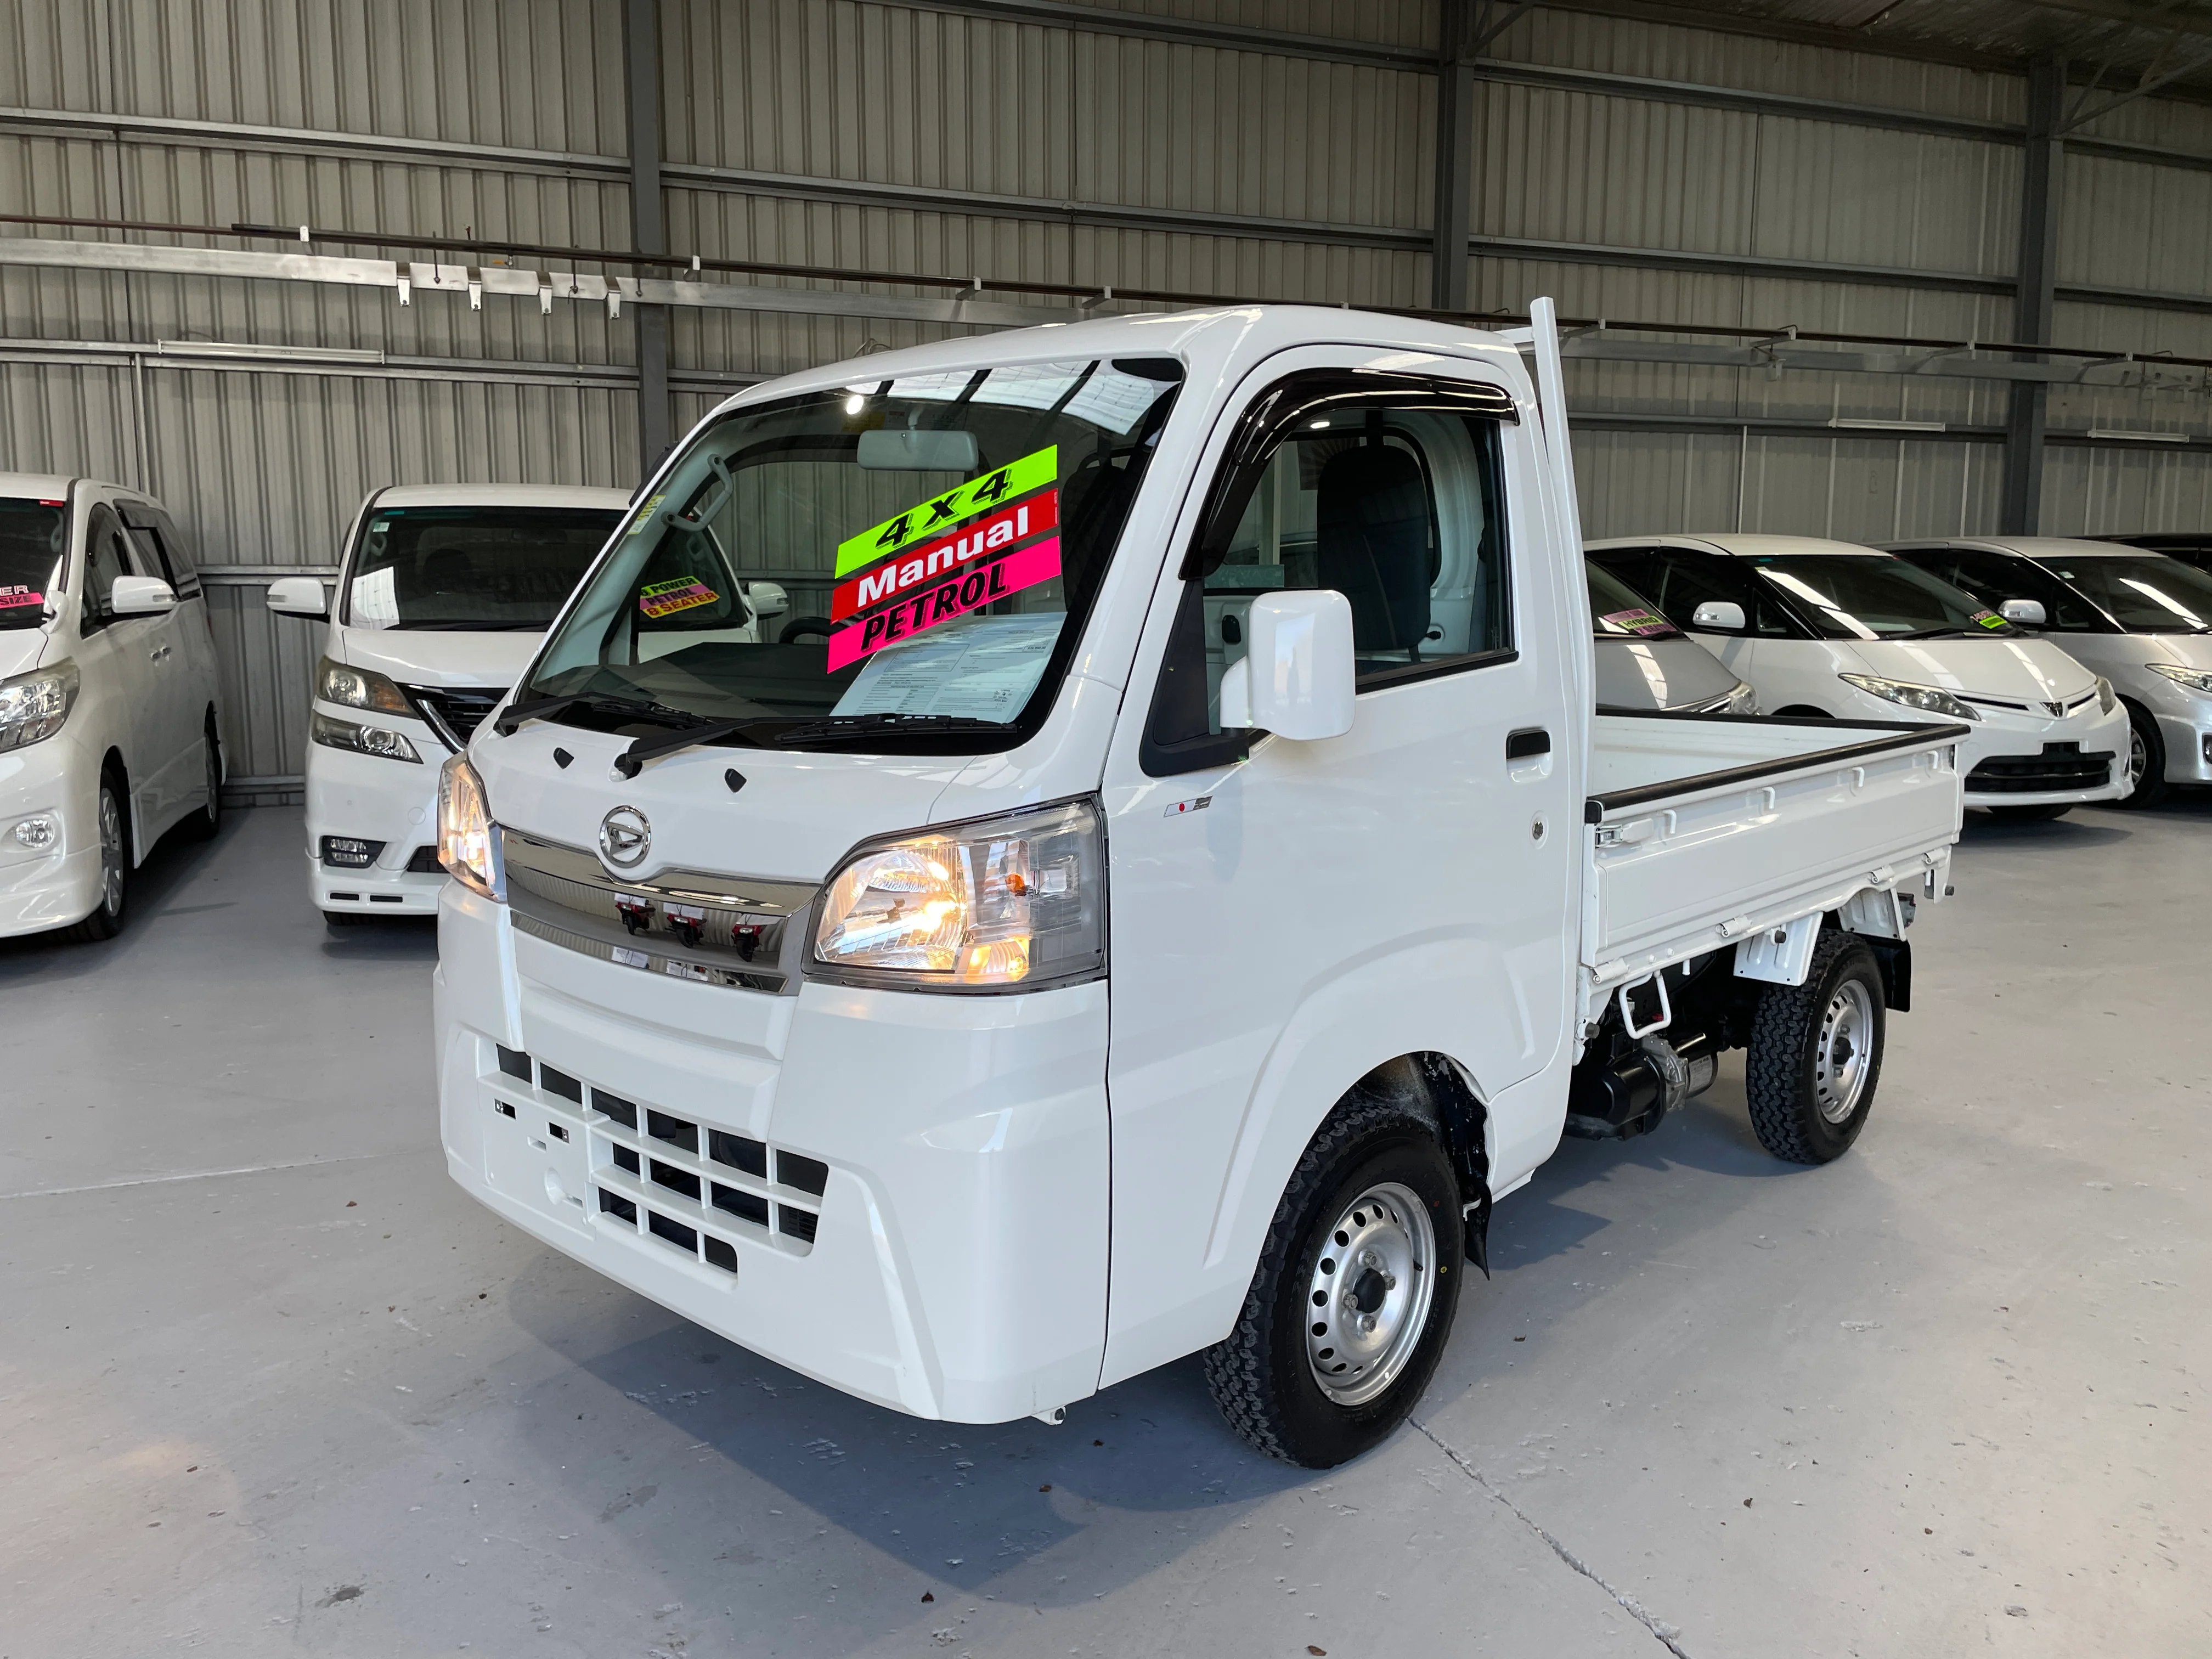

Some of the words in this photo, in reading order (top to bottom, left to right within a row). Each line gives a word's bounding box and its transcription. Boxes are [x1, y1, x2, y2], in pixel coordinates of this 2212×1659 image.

[874, 513, 914, 550] 4
[972, 468, 1014, 505] 4
[857, 505, 1029, 608] Manual
[645, 588, 697, 606] PETROL
[650, 578, 698, 594] POWER
[647, 607, 662, 616] 8
[660, 592, 719, 612] SEATER
[860, 562, 1010, 652] PETROL
[1622, 616, 1658, 628] HYBRID
